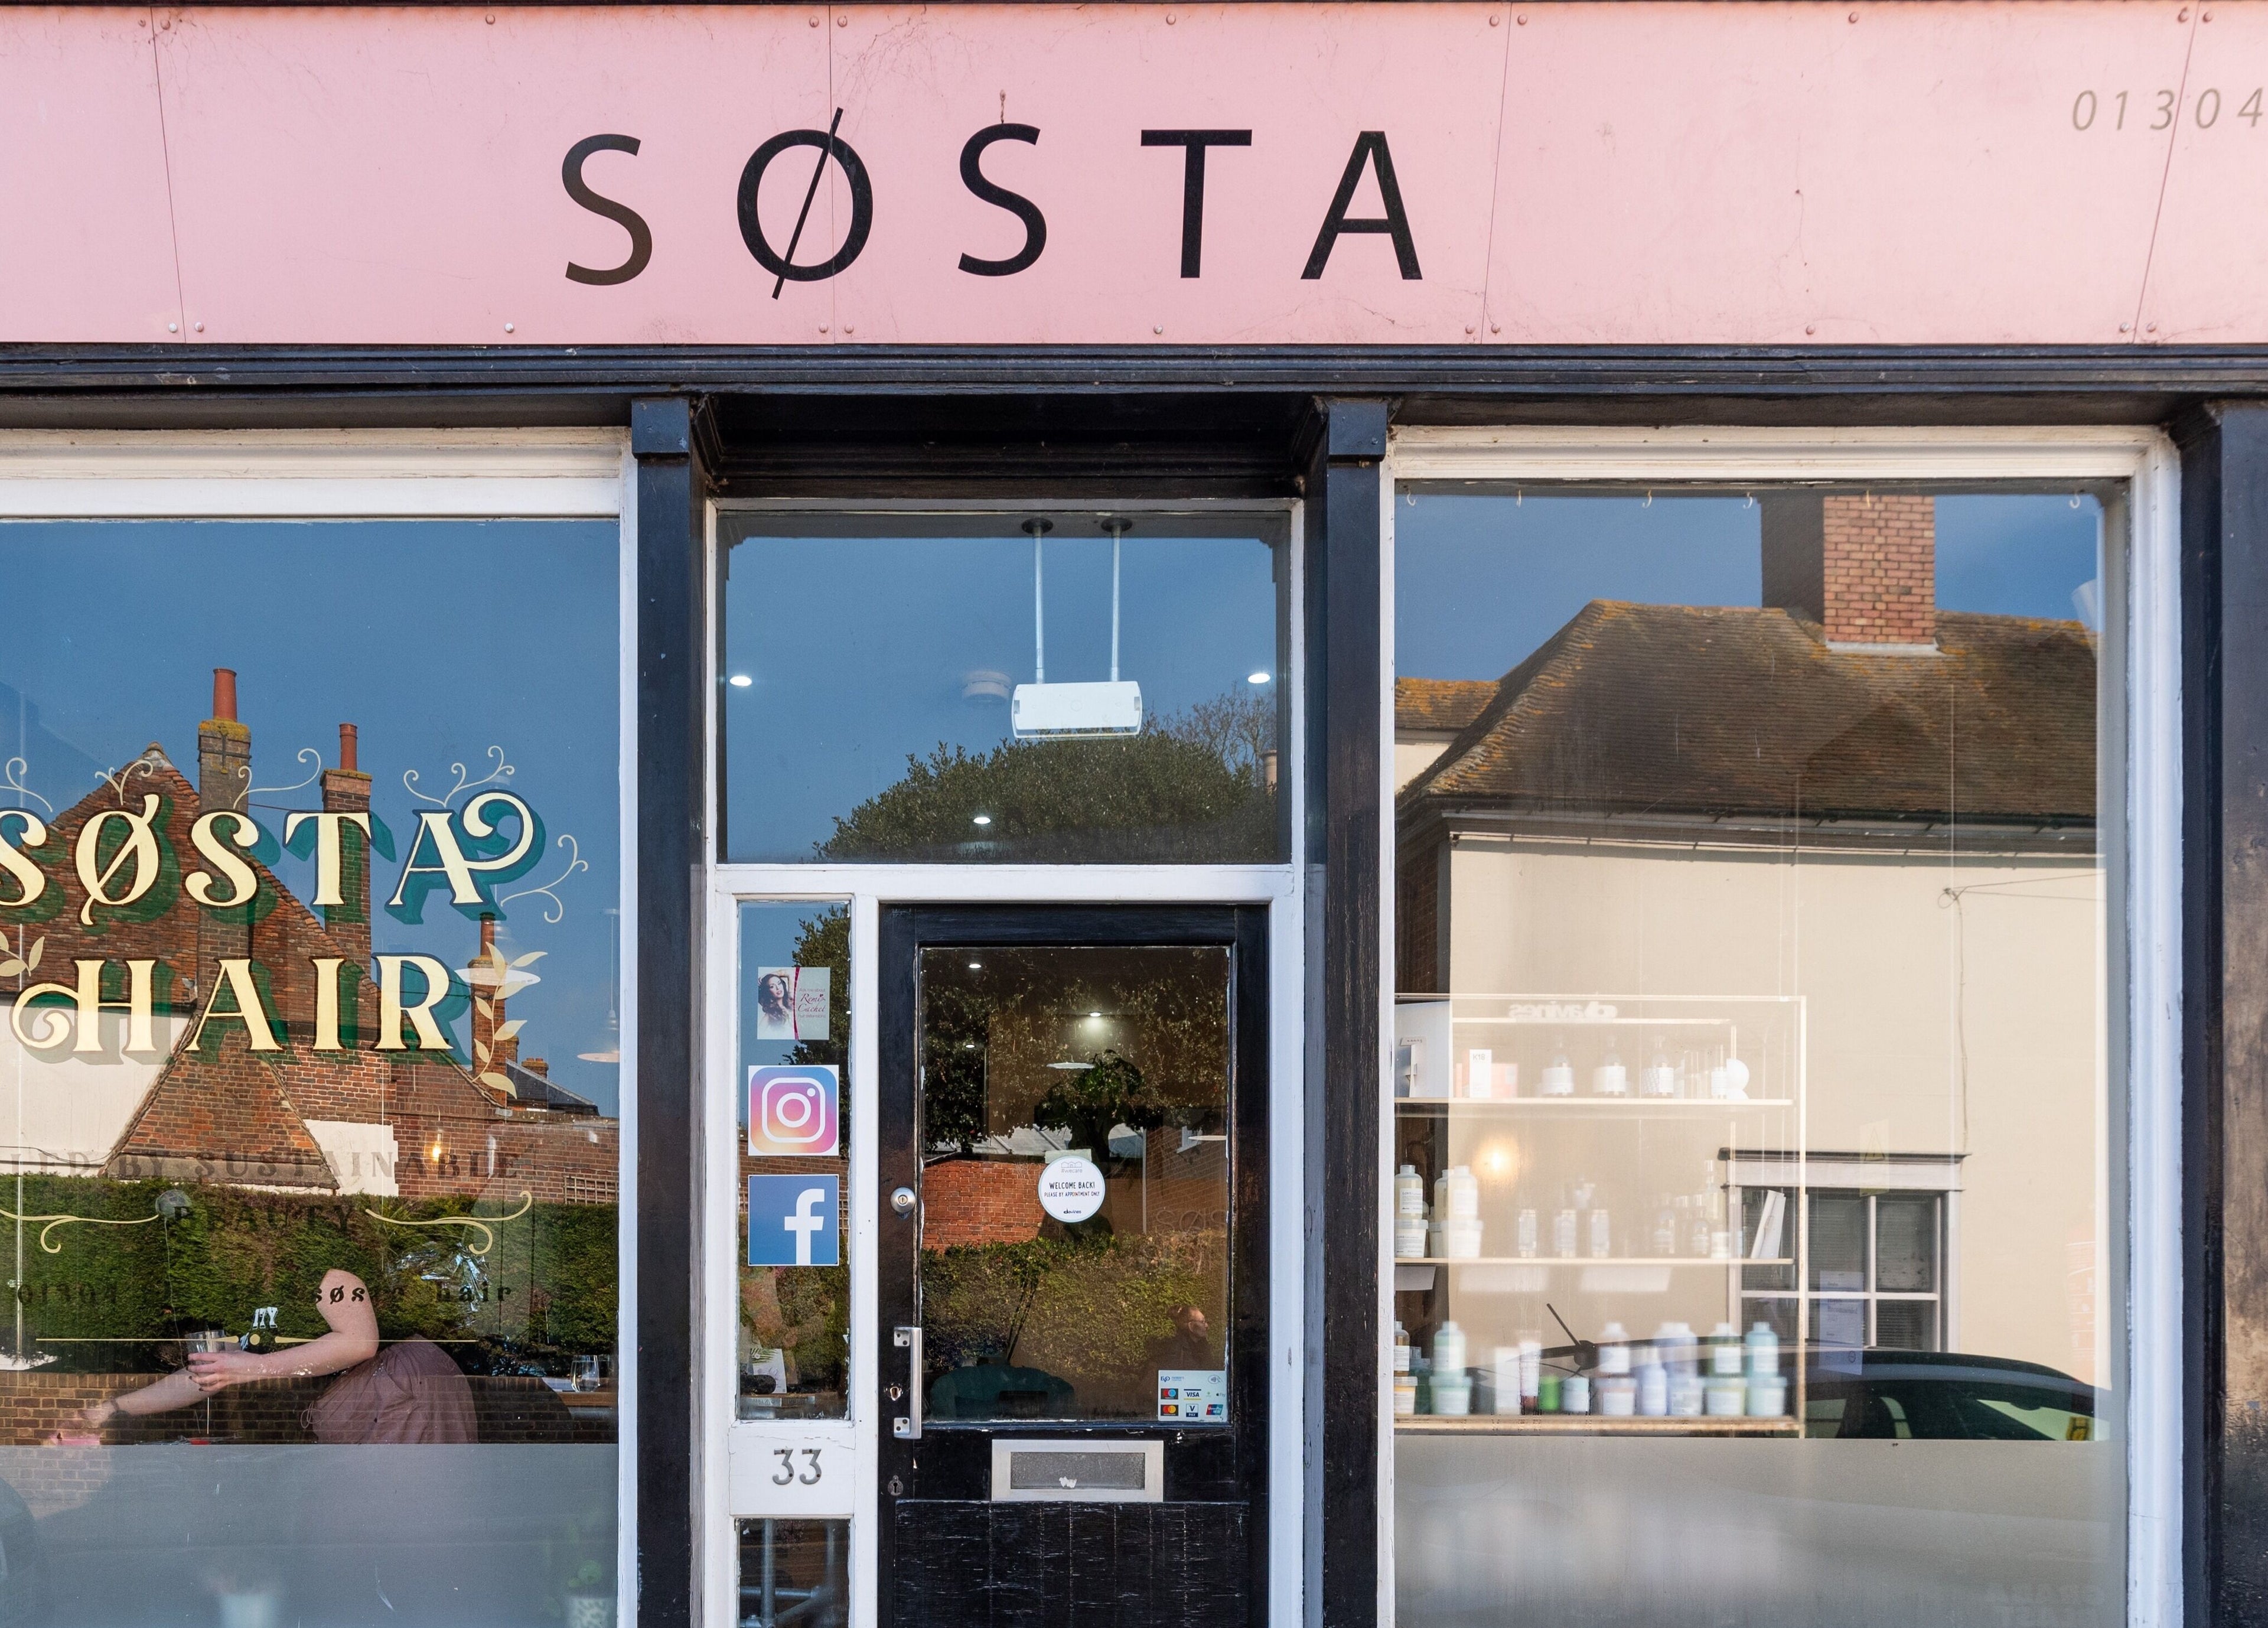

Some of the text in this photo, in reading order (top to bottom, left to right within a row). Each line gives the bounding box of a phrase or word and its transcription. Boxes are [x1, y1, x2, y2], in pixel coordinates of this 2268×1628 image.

[2072, 87, 2264, 131] 01304
[561, 107, 1423, 300] SØSTA
[9, 953, 455, 1053] HAIR
[800, 993, 826, 1004] Remi
[1049, 1181, 1076, 1190] WELCOME
[772, 1448, 822, 1485] 33
